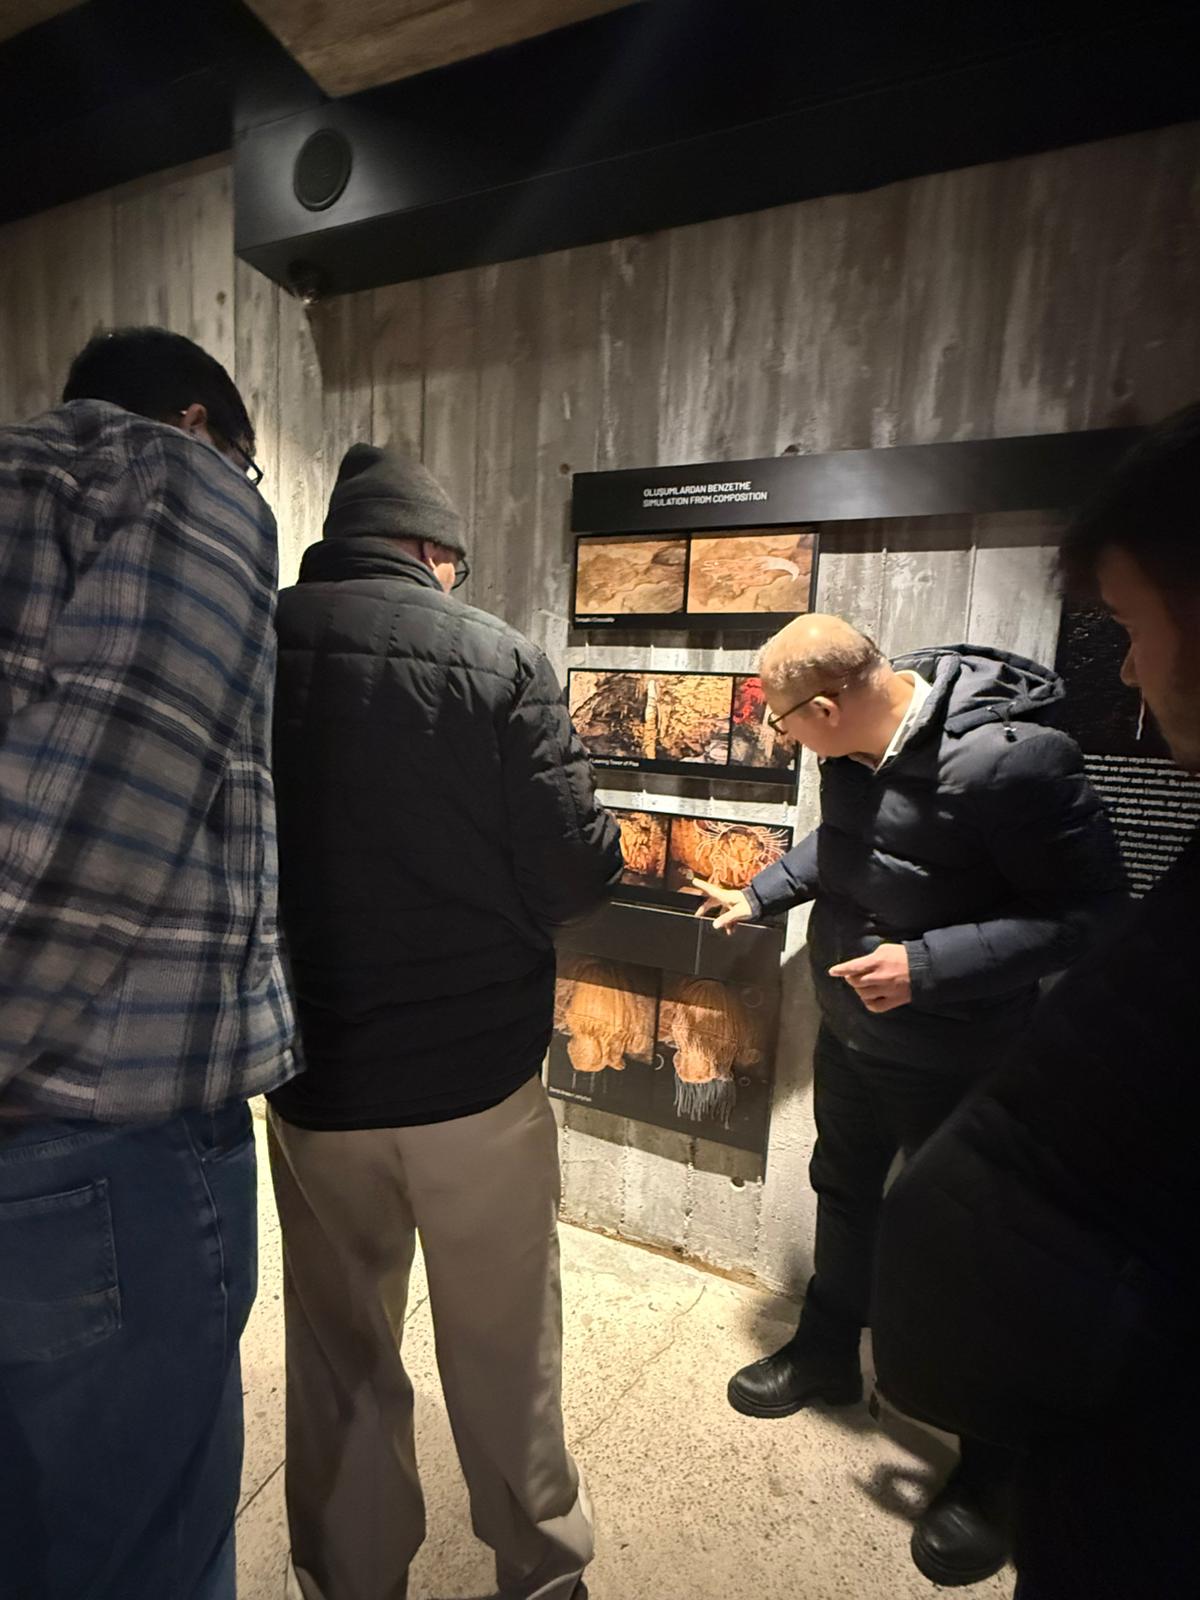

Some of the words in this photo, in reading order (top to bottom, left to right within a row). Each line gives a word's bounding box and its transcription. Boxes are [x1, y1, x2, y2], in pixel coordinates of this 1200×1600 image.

[643, 485, 706, 497] OLUŞUMLARDAN
[707, 481, 752, 493] BENZETME
[643, 497, 689, 507] SIMULATION
[689, 495, 712, 504] FROM
[712, 492, 768, 503] COMPOSITION
